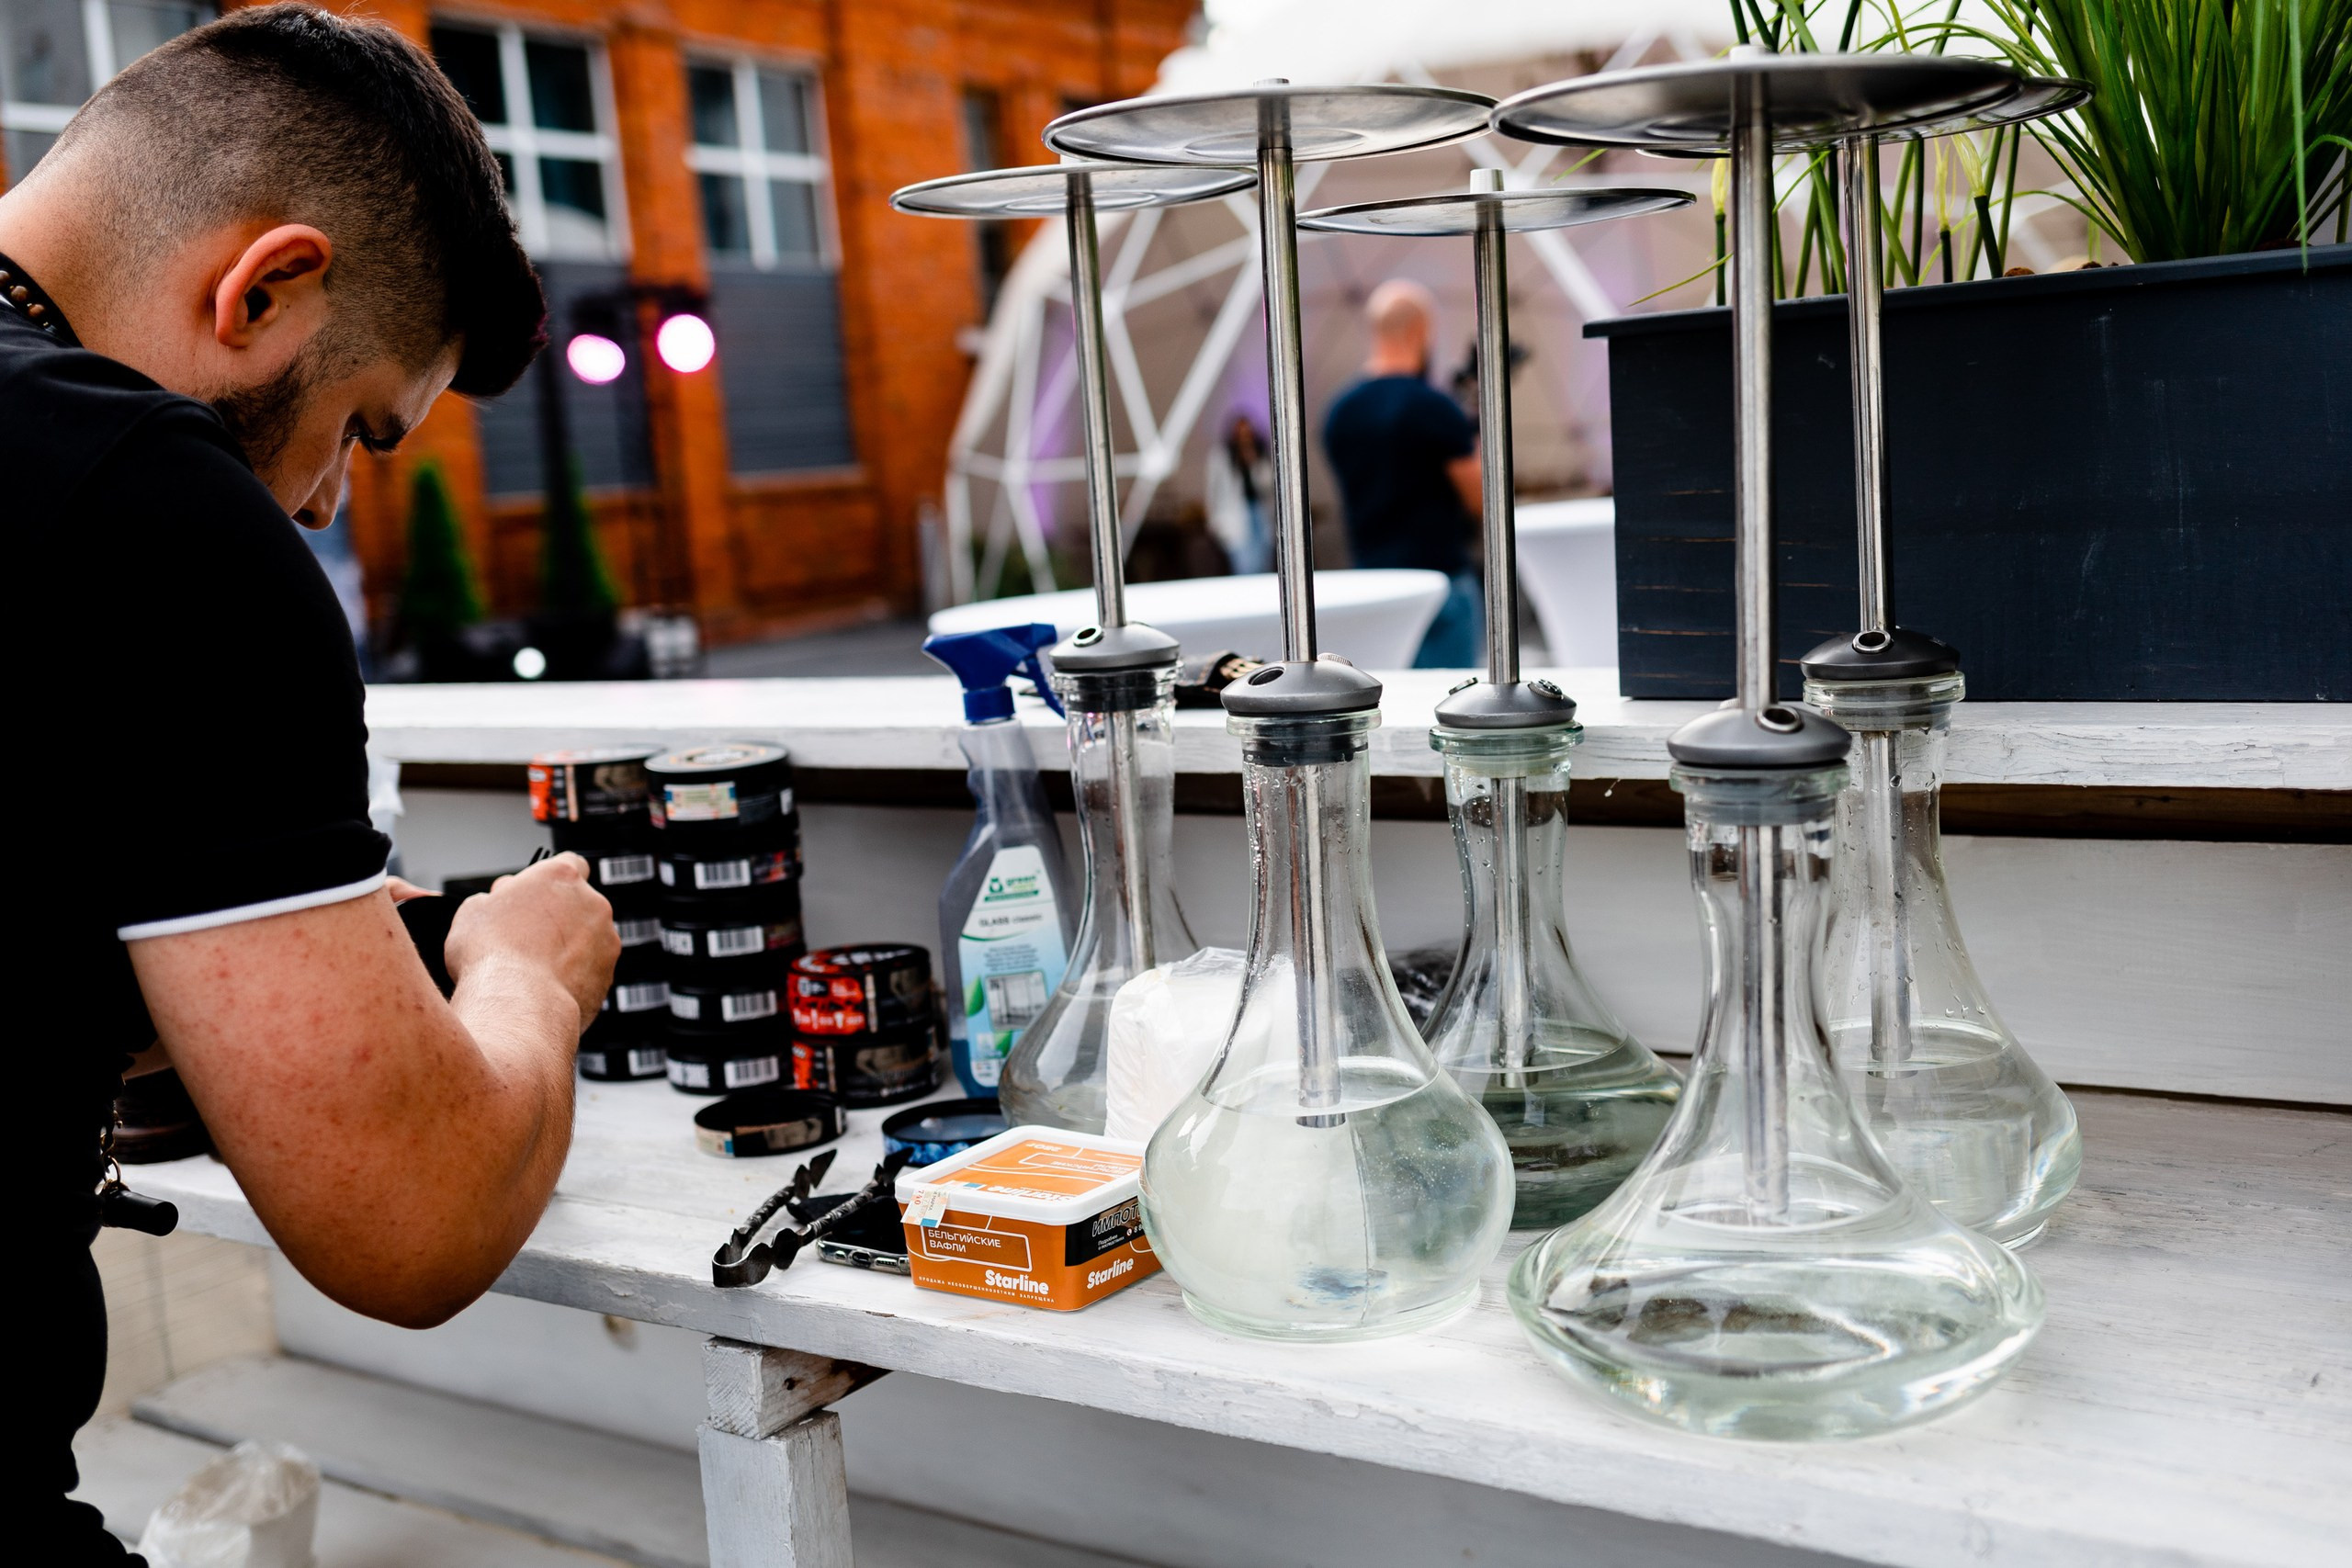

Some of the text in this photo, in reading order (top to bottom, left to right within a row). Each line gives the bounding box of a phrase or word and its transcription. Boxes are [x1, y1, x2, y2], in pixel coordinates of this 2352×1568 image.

[1091, 1203, 1140, 1237] ИМПОТ
[928, 1229, 1001, 1247] БЕЛЬГИЙСКИЕ
[930, 1240, 967, 1252] ВАФЛИ
[985, 1269, 1049, 1295] Starline
[1087, 1258, 1134, 1289] Starline
[919, 1276, 945, 1285] ПРОДАЖА
[1019, 1293, 1056, 1303] ЗАПРЕЩЕНА
